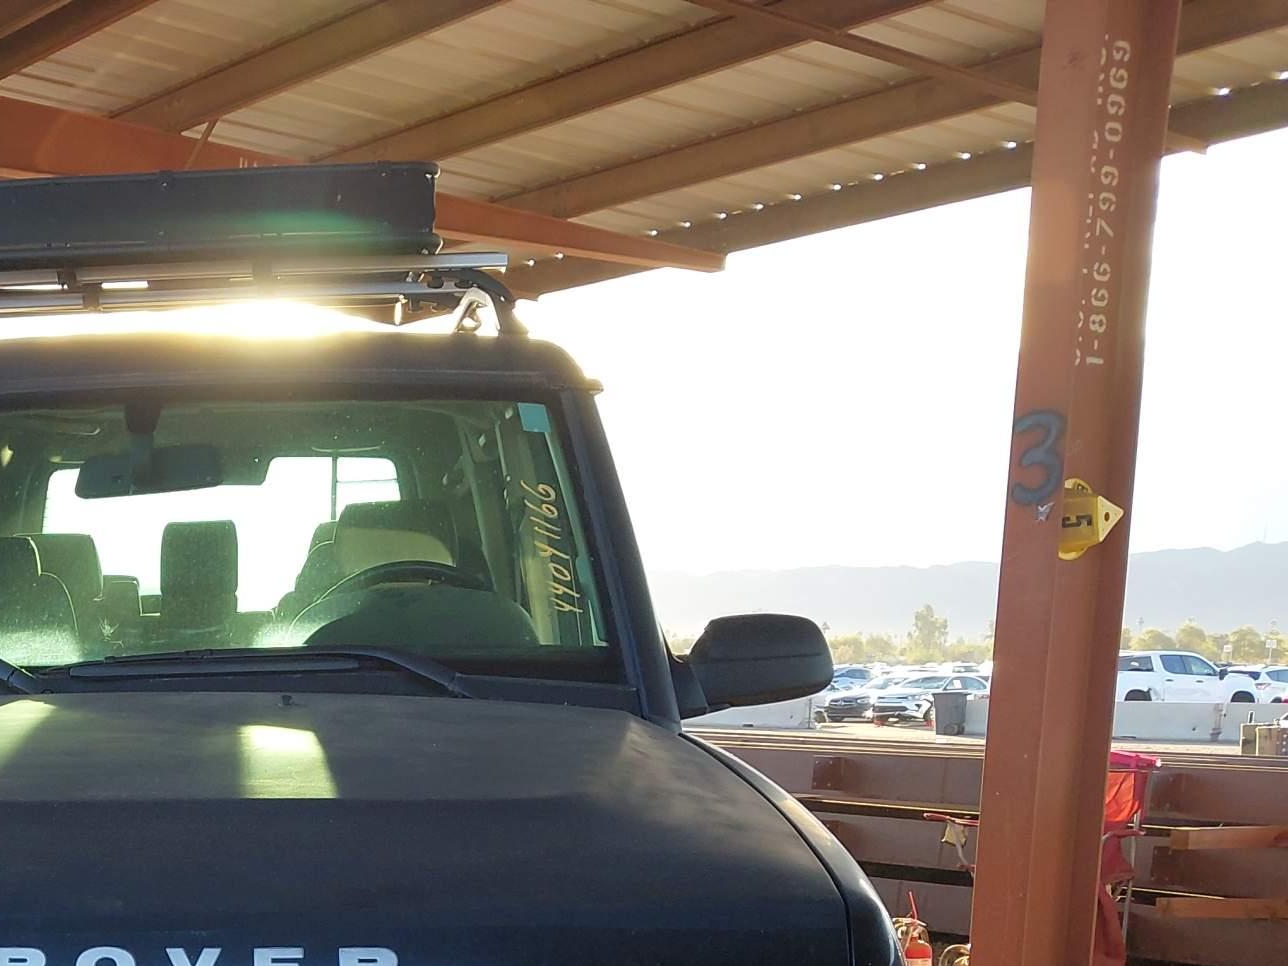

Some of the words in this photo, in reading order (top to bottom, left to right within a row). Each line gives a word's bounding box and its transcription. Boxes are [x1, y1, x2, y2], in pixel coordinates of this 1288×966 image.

[1086, 39, 1131, 366] 1-866-799-0969
[1012, 409, 1067, 505] 3
[519, 479, 584, 613] 44041166
